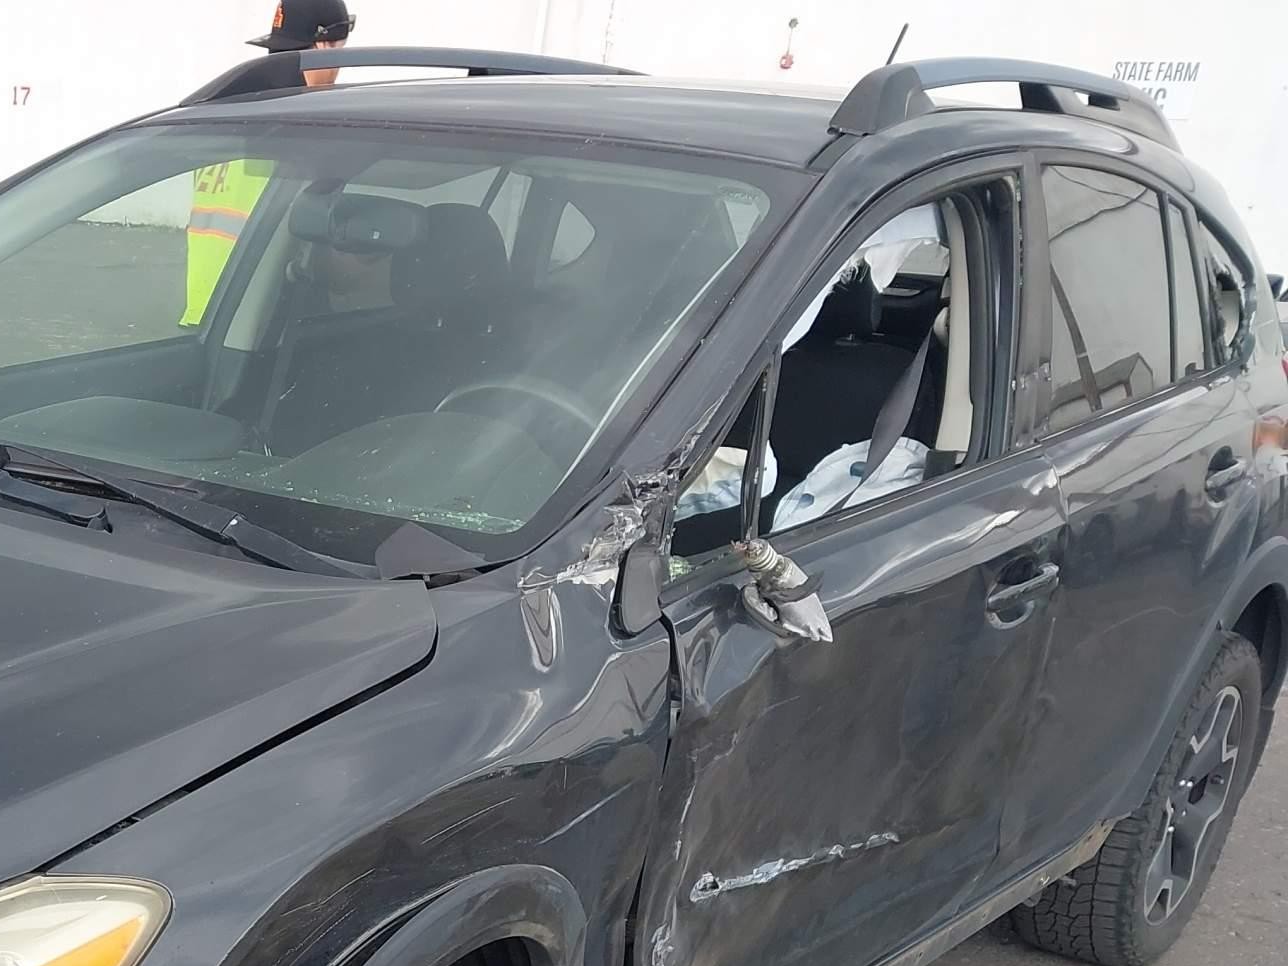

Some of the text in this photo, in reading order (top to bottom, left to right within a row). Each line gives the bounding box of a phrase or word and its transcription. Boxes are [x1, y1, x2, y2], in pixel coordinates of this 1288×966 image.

[1113, 61, 1200, 82] STATE FARM
[12, 86, 31, 106] 17
